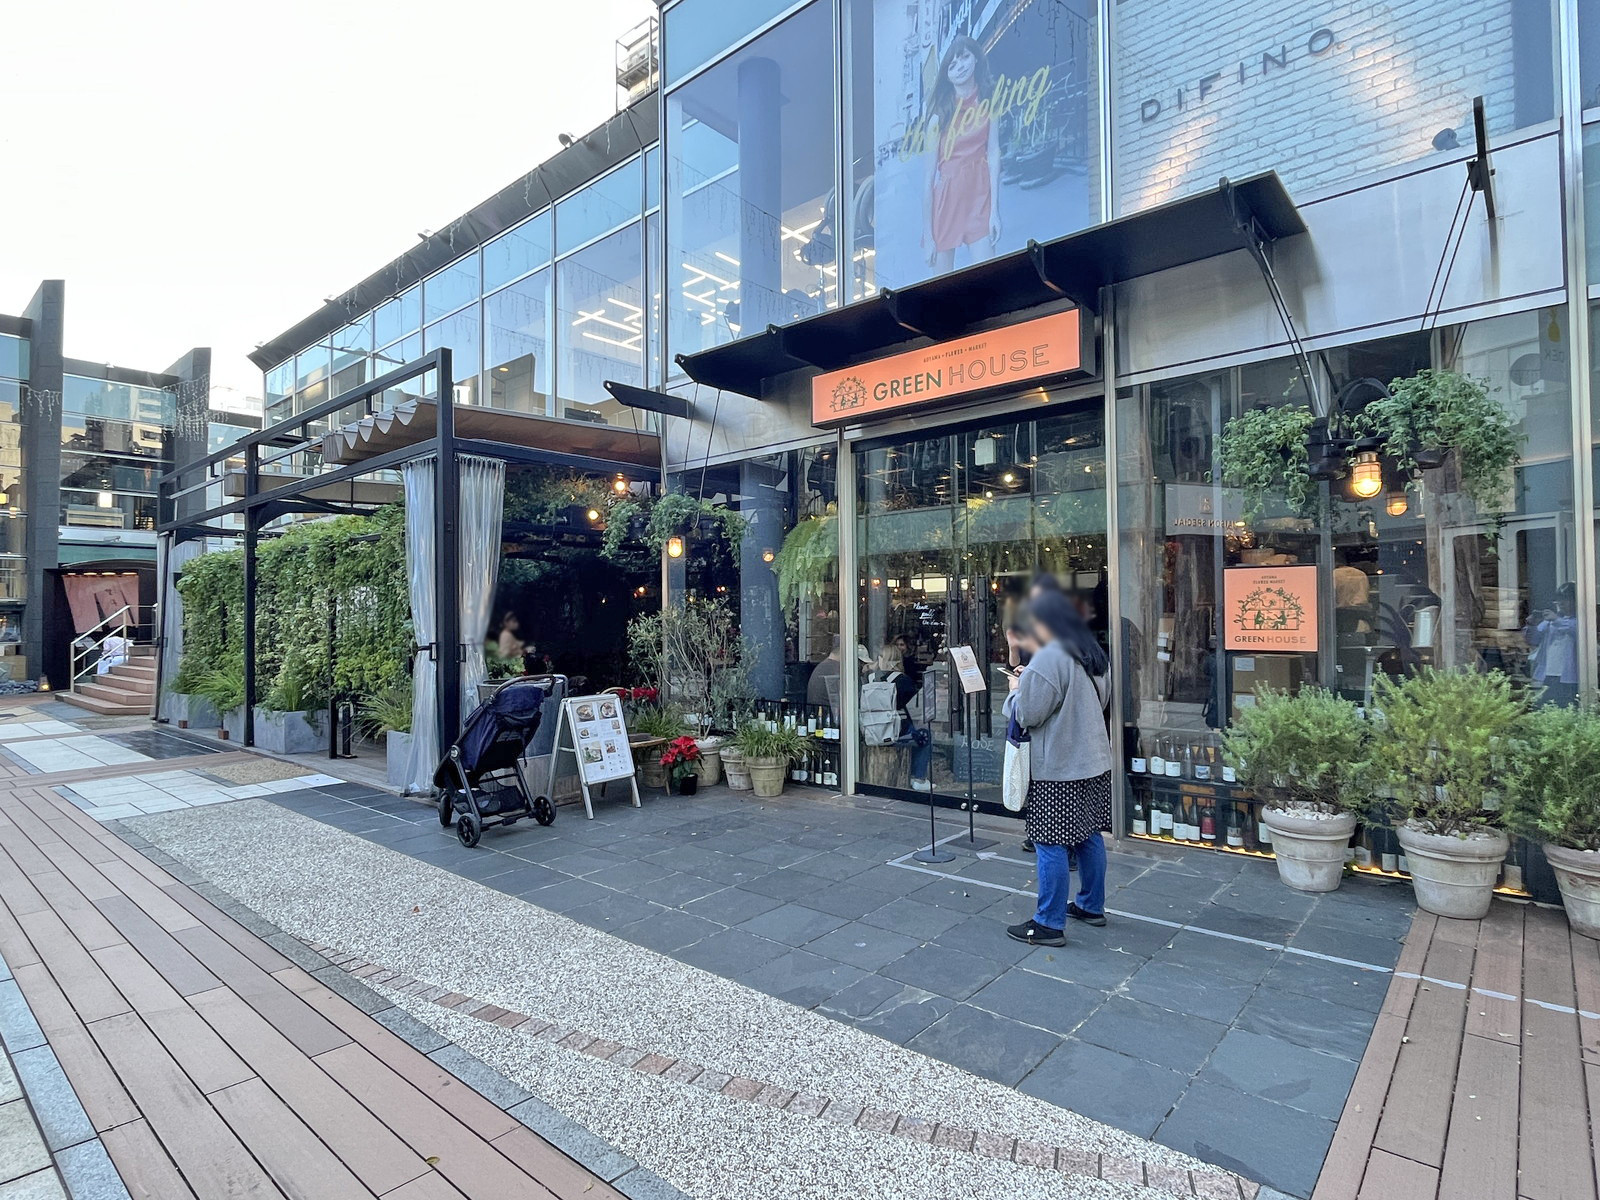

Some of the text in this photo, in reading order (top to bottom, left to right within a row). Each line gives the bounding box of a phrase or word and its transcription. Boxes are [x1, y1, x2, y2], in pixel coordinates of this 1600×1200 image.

[1141, 28, 1334, 123] DIFINO
[944, 64, 1052, 162] feeling
[873, 343, 1050, 402] GREEN HOUSE
[968, 342, 987, 351] MARKET
[1234, 635, 1307, 644] GREEN HOUSE
